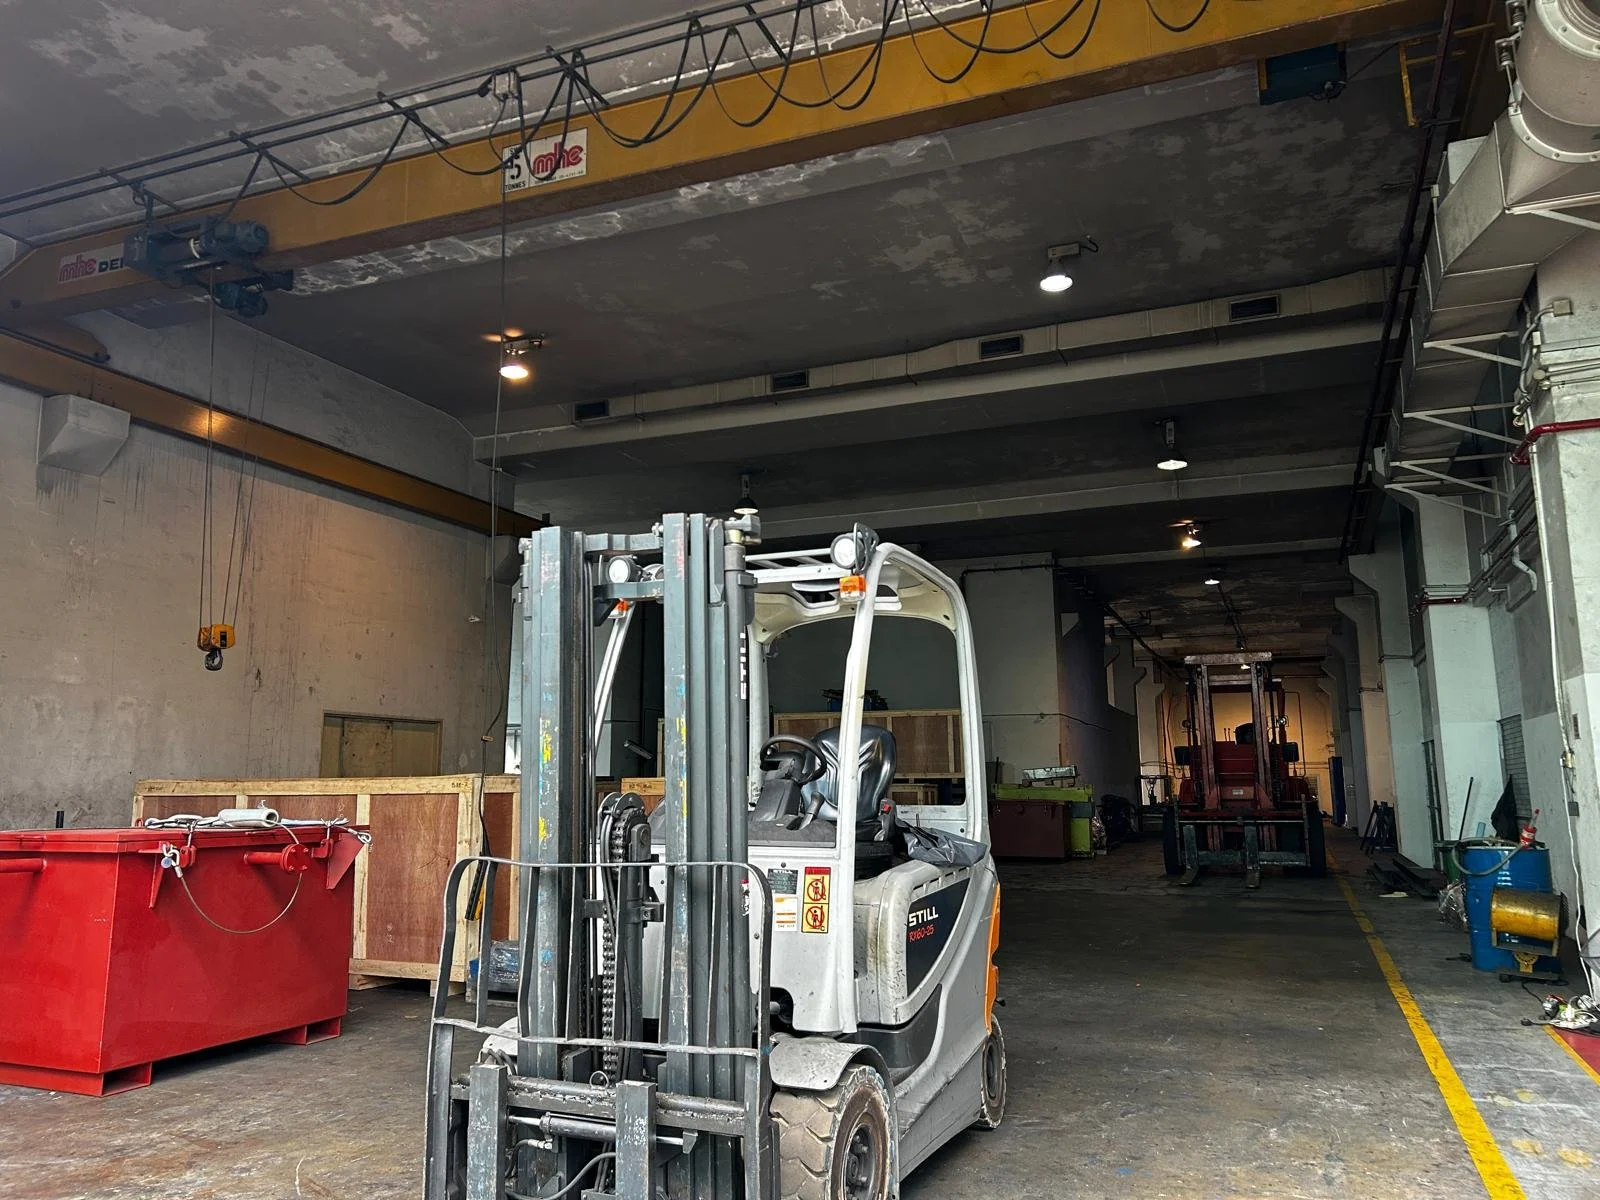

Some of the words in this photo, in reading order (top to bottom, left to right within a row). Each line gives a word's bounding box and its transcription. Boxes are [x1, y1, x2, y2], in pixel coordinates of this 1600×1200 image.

[504, 181, 526, 191] TONNES
[59, 254, 97, 281] mhe
[909, 906, 939, 926] STILL
